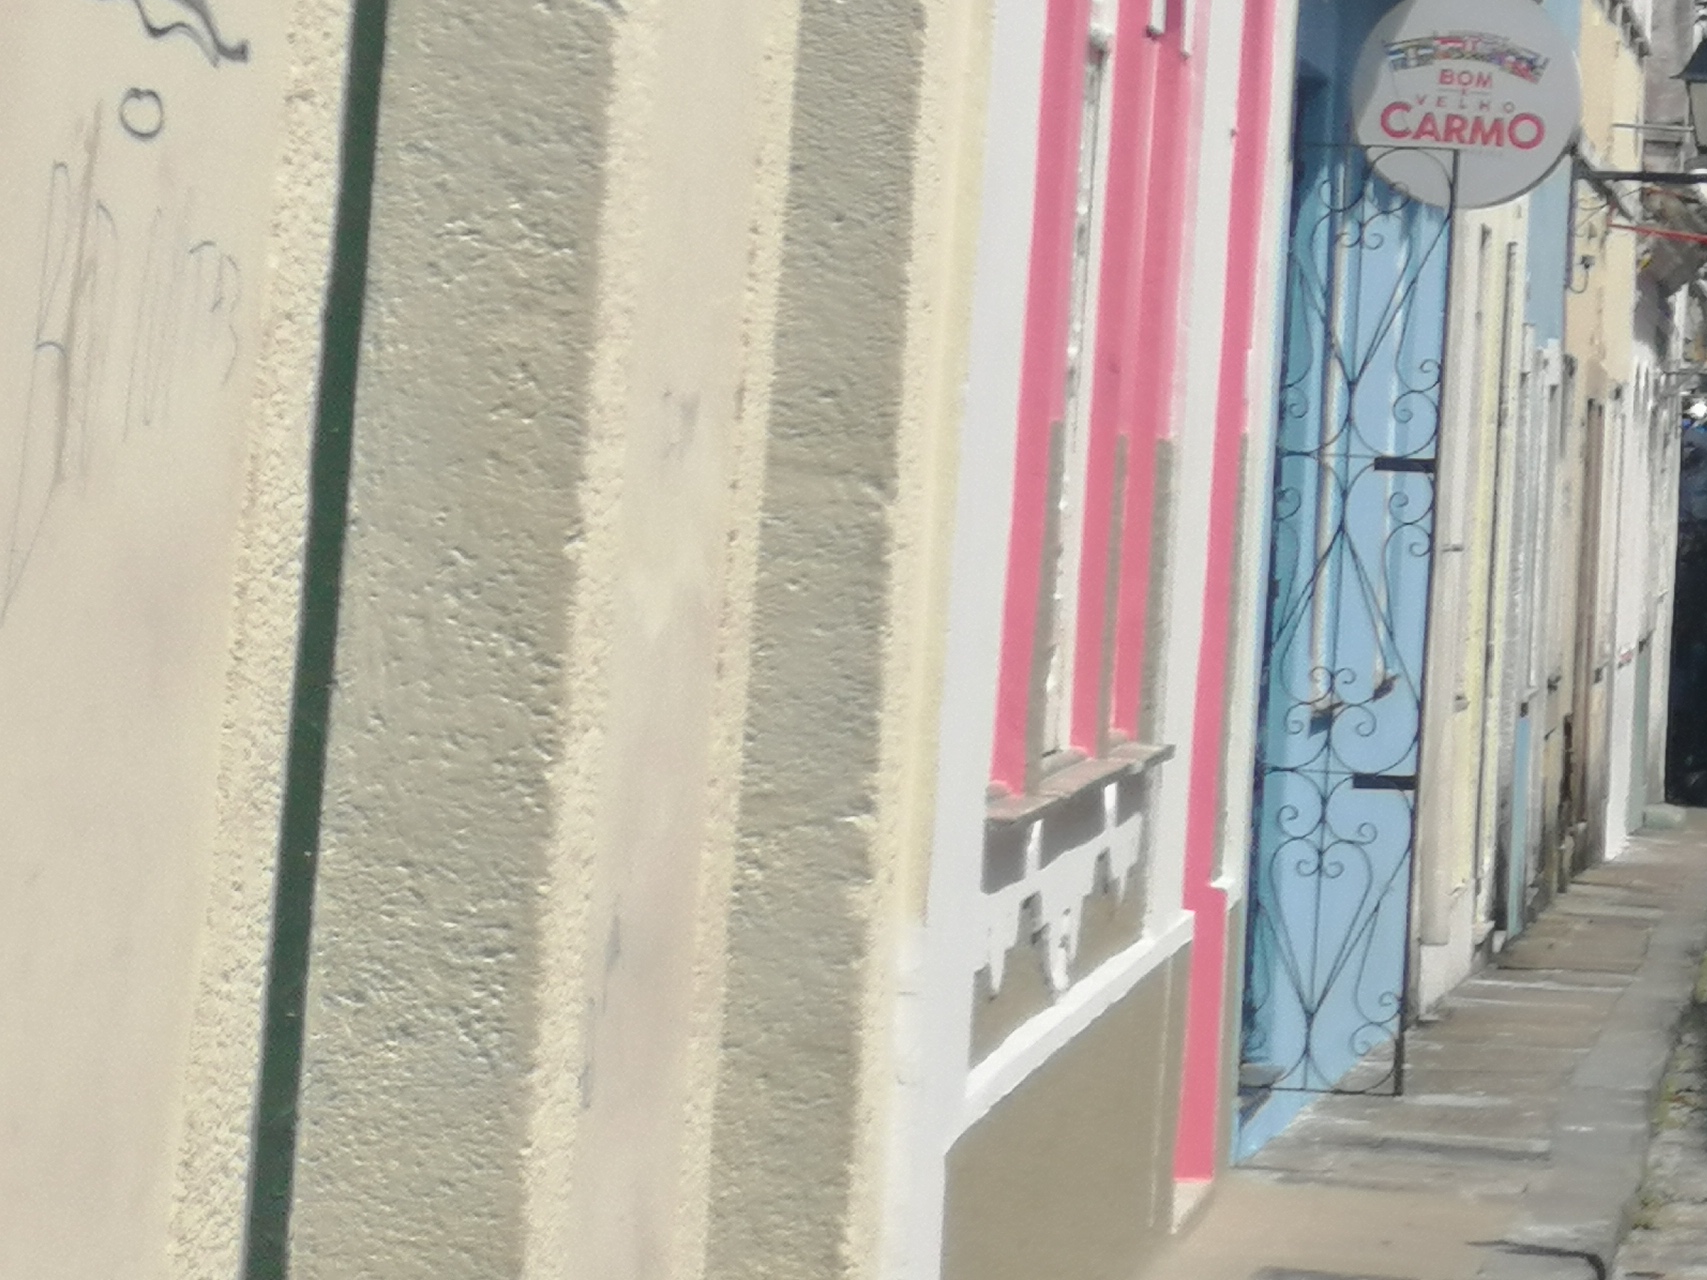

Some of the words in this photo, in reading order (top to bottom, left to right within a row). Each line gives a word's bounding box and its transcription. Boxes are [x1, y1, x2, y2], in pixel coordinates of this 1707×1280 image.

[1439, 69, 1492, 88] BOM
[1415, 94, 1515, 113] VELHO
[1380, 101, 1545, 150] CARMO
